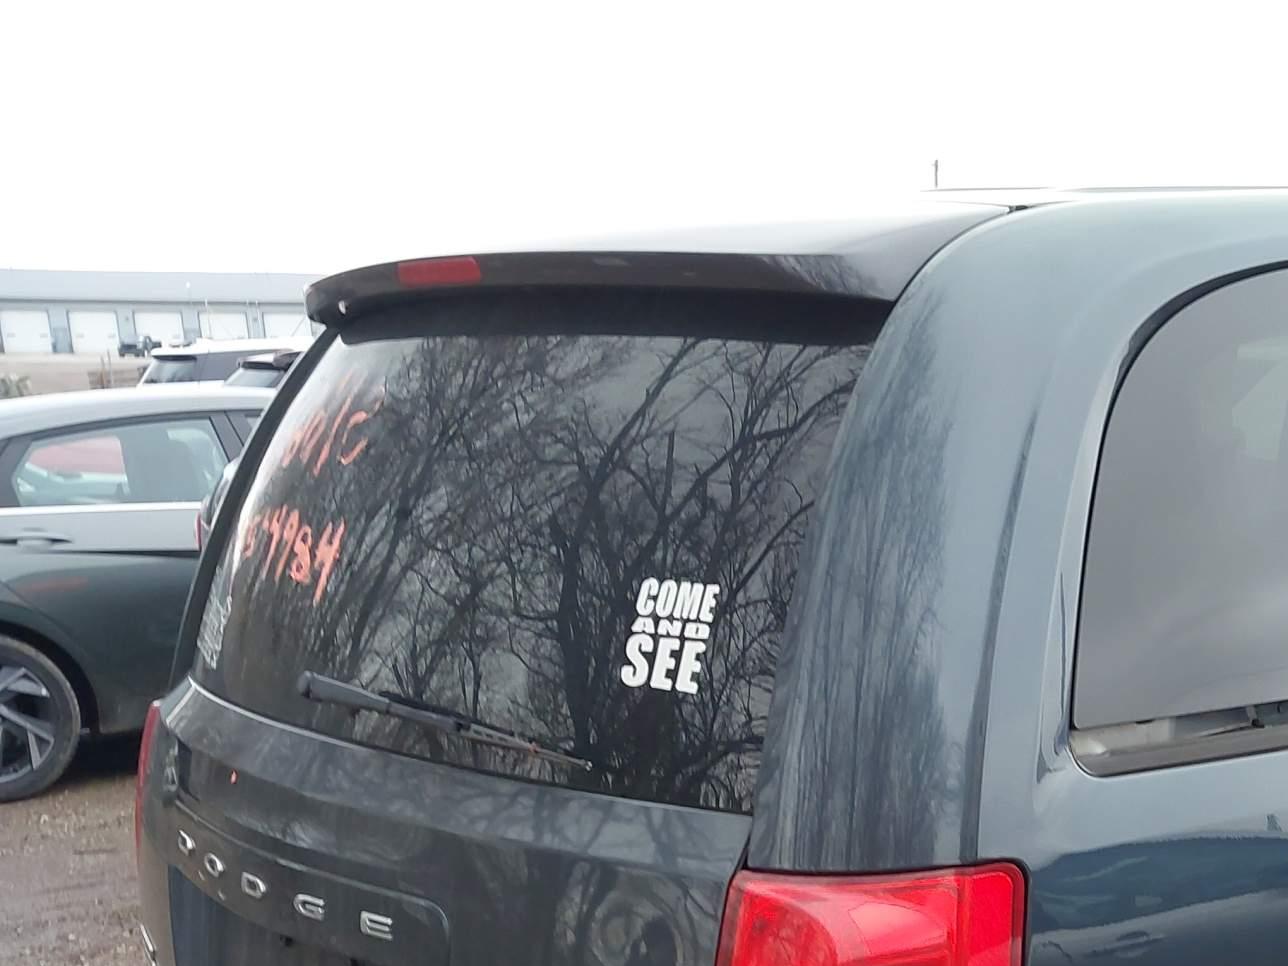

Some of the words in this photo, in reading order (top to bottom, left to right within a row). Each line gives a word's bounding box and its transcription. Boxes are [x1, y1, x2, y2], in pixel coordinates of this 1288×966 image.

[635, 577, 721, 623] COME
[631, 616, 711, 640] AND
[620, 634, 706, 695] SEE
[177, 829, 394, 941] DODGE
